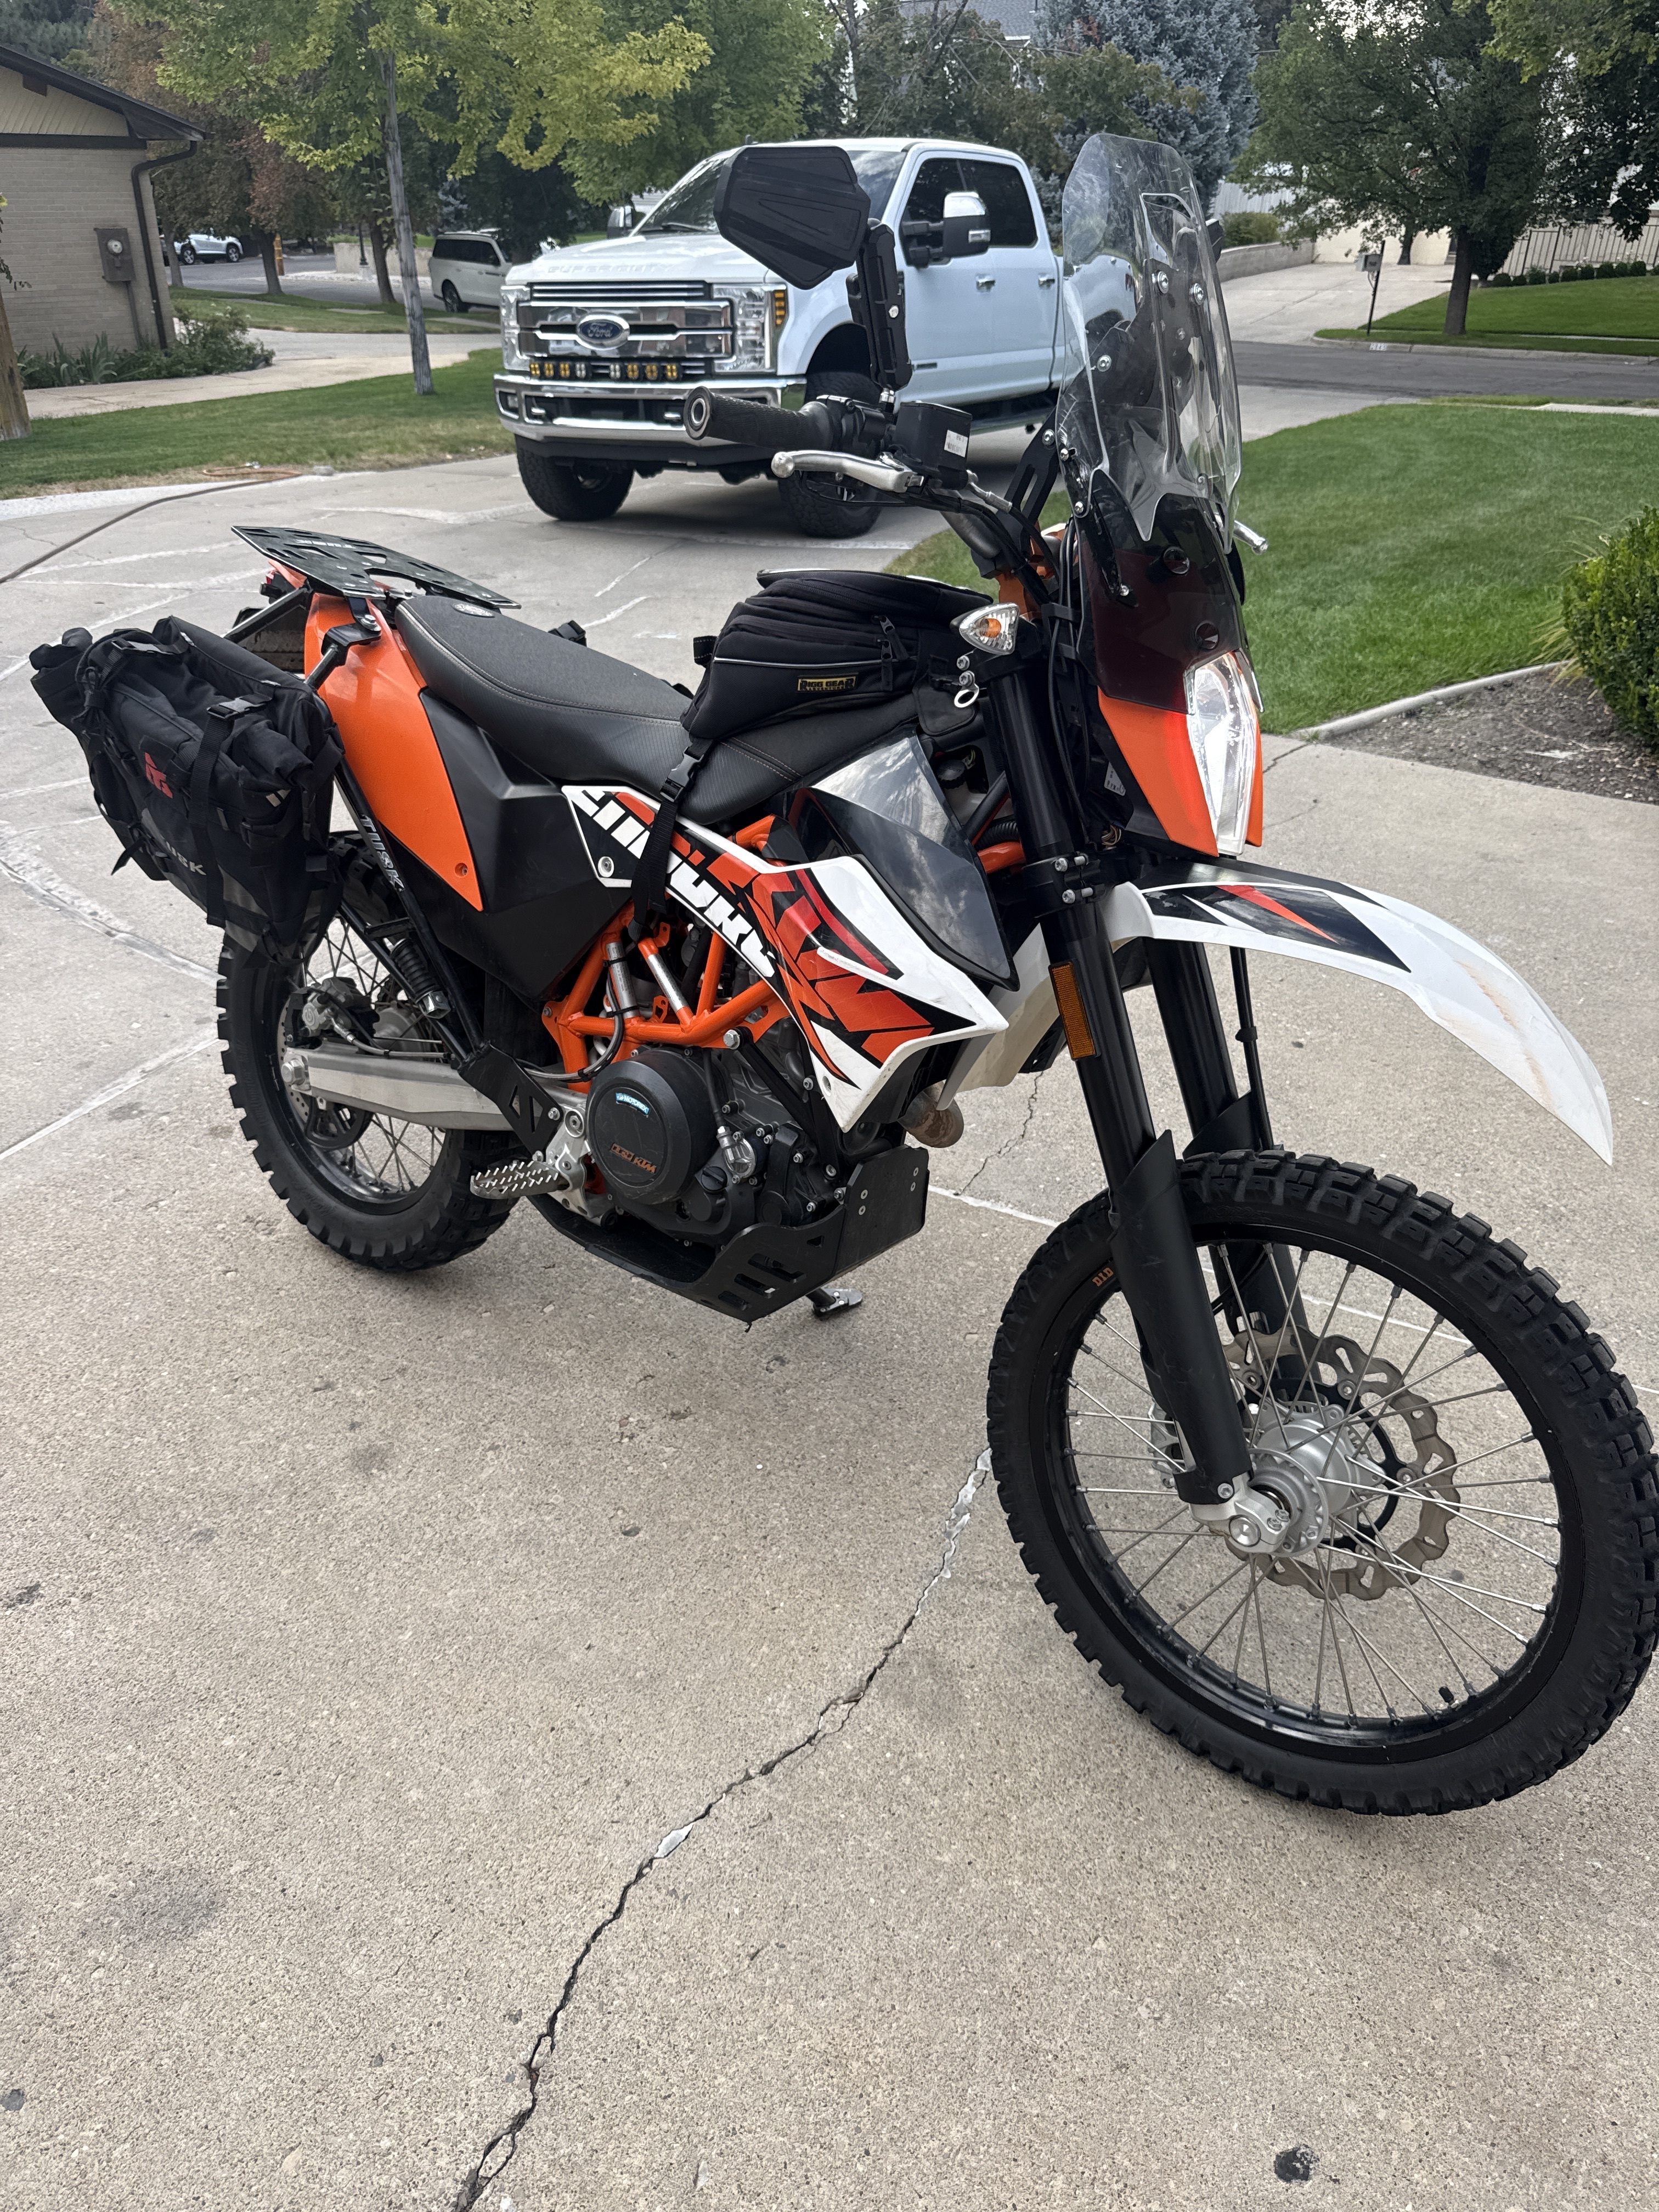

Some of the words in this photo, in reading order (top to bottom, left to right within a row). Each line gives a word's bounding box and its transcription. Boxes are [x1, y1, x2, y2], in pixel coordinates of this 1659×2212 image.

[587, 323, 613, 338] Ford
[799, 680, 823, 691] RIGG
[825, 678, 855, 689] GEAR
[165, 840, 207, 876] USK
[360, 814, 405, 888] TUSK
[624, 1094, 648, 1114] MOTOREX
[633, 1156, 657, 1174] KTM
